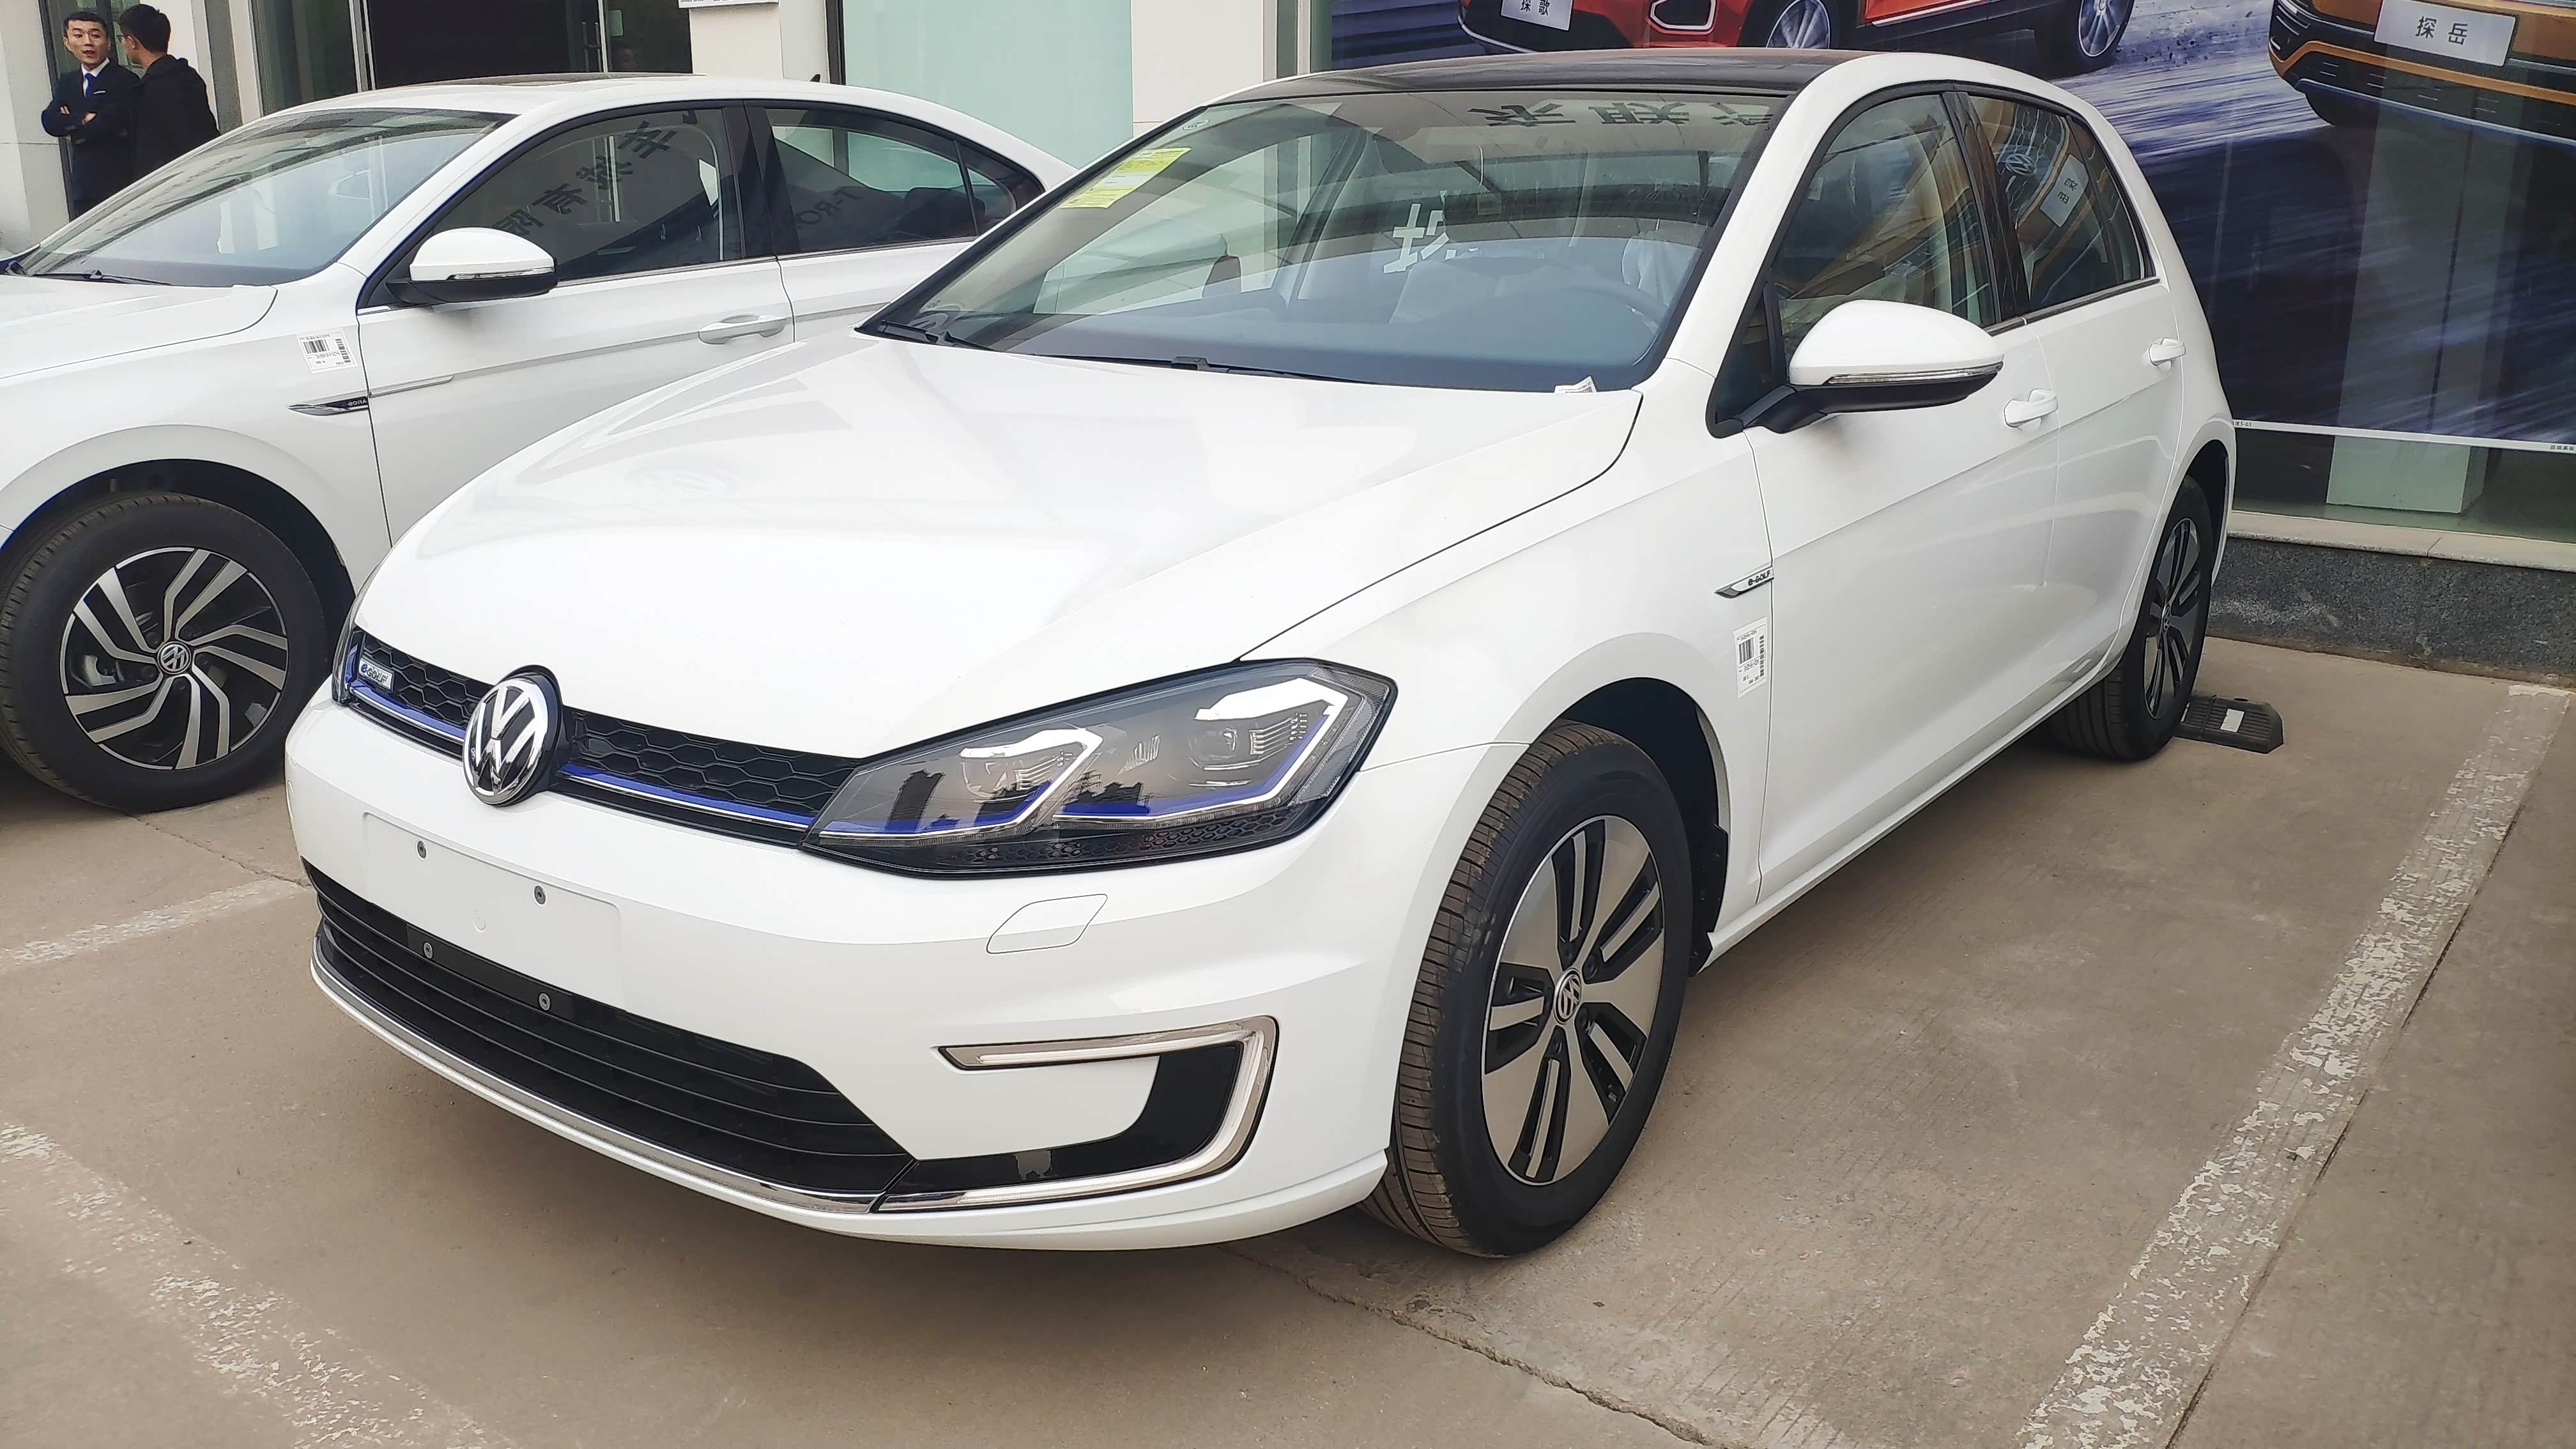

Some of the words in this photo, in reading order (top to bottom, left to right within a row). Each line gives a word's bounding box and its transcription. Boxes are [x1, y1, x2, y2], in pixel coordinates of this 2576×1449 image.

[1521, 0, 1551, 16] 探歌
[2415, 15, 2469, 46] 探岳
[1747, 569, 1771, 586] e-GOLF
